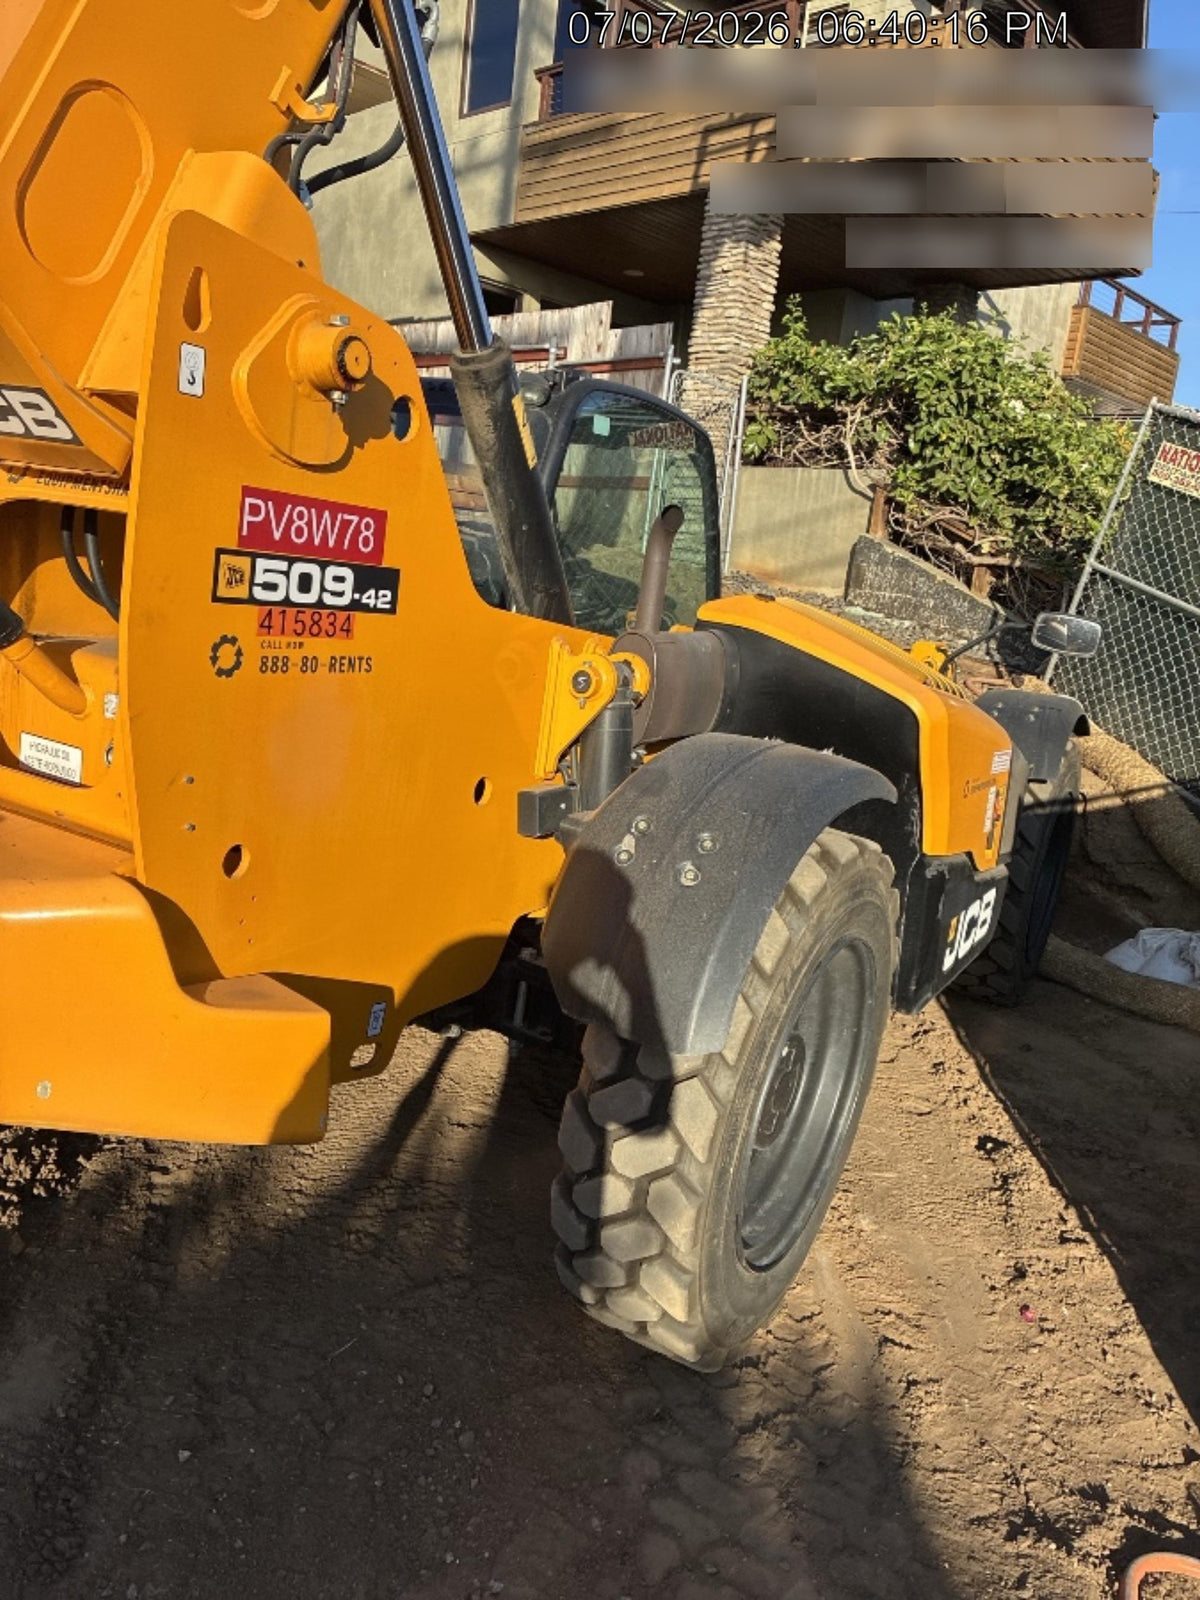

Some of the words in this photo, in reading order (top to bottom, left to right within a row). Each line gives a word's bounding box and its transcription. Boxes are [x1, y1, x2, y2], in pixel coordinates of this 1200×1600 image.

[1158, 444, 1200, 474] NATIO
[241, 496, 376, 554] PV8W78
[251, 557, 393, 609] 509-42
[258, 607, 353, 639] 415834
[260, 640, 283, 650] CALL
[258, 655, 373, 675] 888-80-RENTS
[942, 887, 997, 971] JCB
